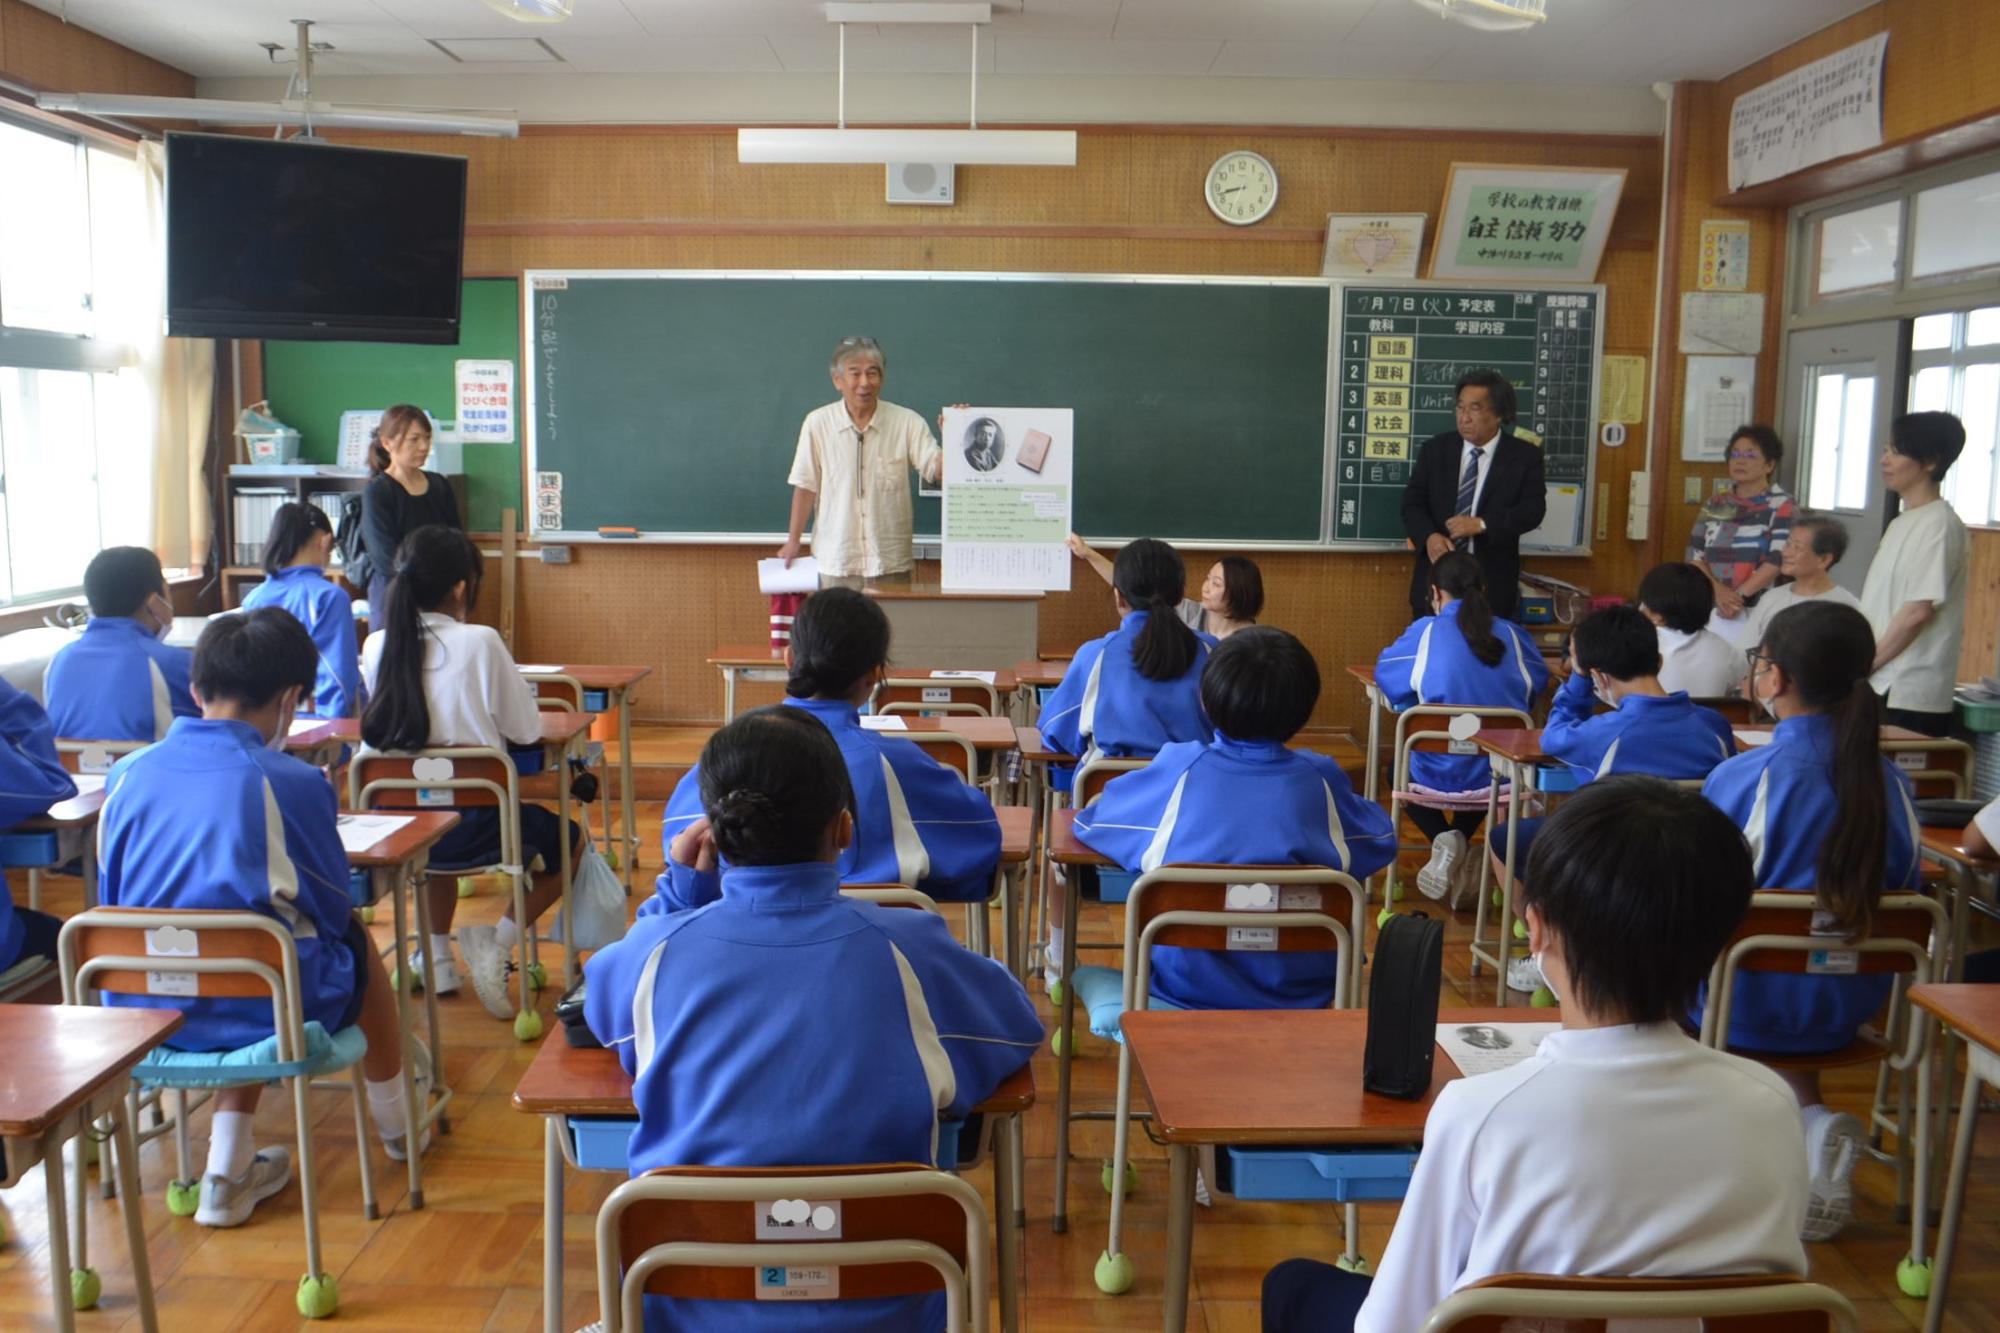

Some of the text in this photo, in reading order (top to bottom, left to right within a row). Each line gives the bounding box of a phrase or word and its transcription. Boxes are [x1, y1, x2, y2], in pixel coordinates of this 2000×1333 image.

[1468, 215, 1587, 242] 自主 信頼 努力
[1458, 299, 1496, 313] 予定表
[1369, 319, 1395, 332] 教科
[1455, 321, 1506, 335] 学習内容
[1542, 332, 1548, 342] 1
[1351, 340, 1358, 353] 1
[1377, 340, 1407, 356] 国語
[1540, 350, 1549, 360] 2
[1350, 366, 1358, 379] 2
[1374, 365, 1404, 381] 理科
[1539, 368, 1547, 378] 3
[1349, 390, 1357, 404] 3
[1538, 386, 1547, 396] 4
[1373, 391, 1403, 406] 英語
[1537, 404, 1546, 415] 5
[1348, 415, 1356, 429] 4
[1374, 415, 1403, 431] 社会
[1536, 423, 1545, 433] 6
[1347, 440, 1355, 454] 5
[1372, 441, 1401, 455] 音楽
[1345, 466, 1354, 479] 6
[767, 1268, 778, 1283] 2
